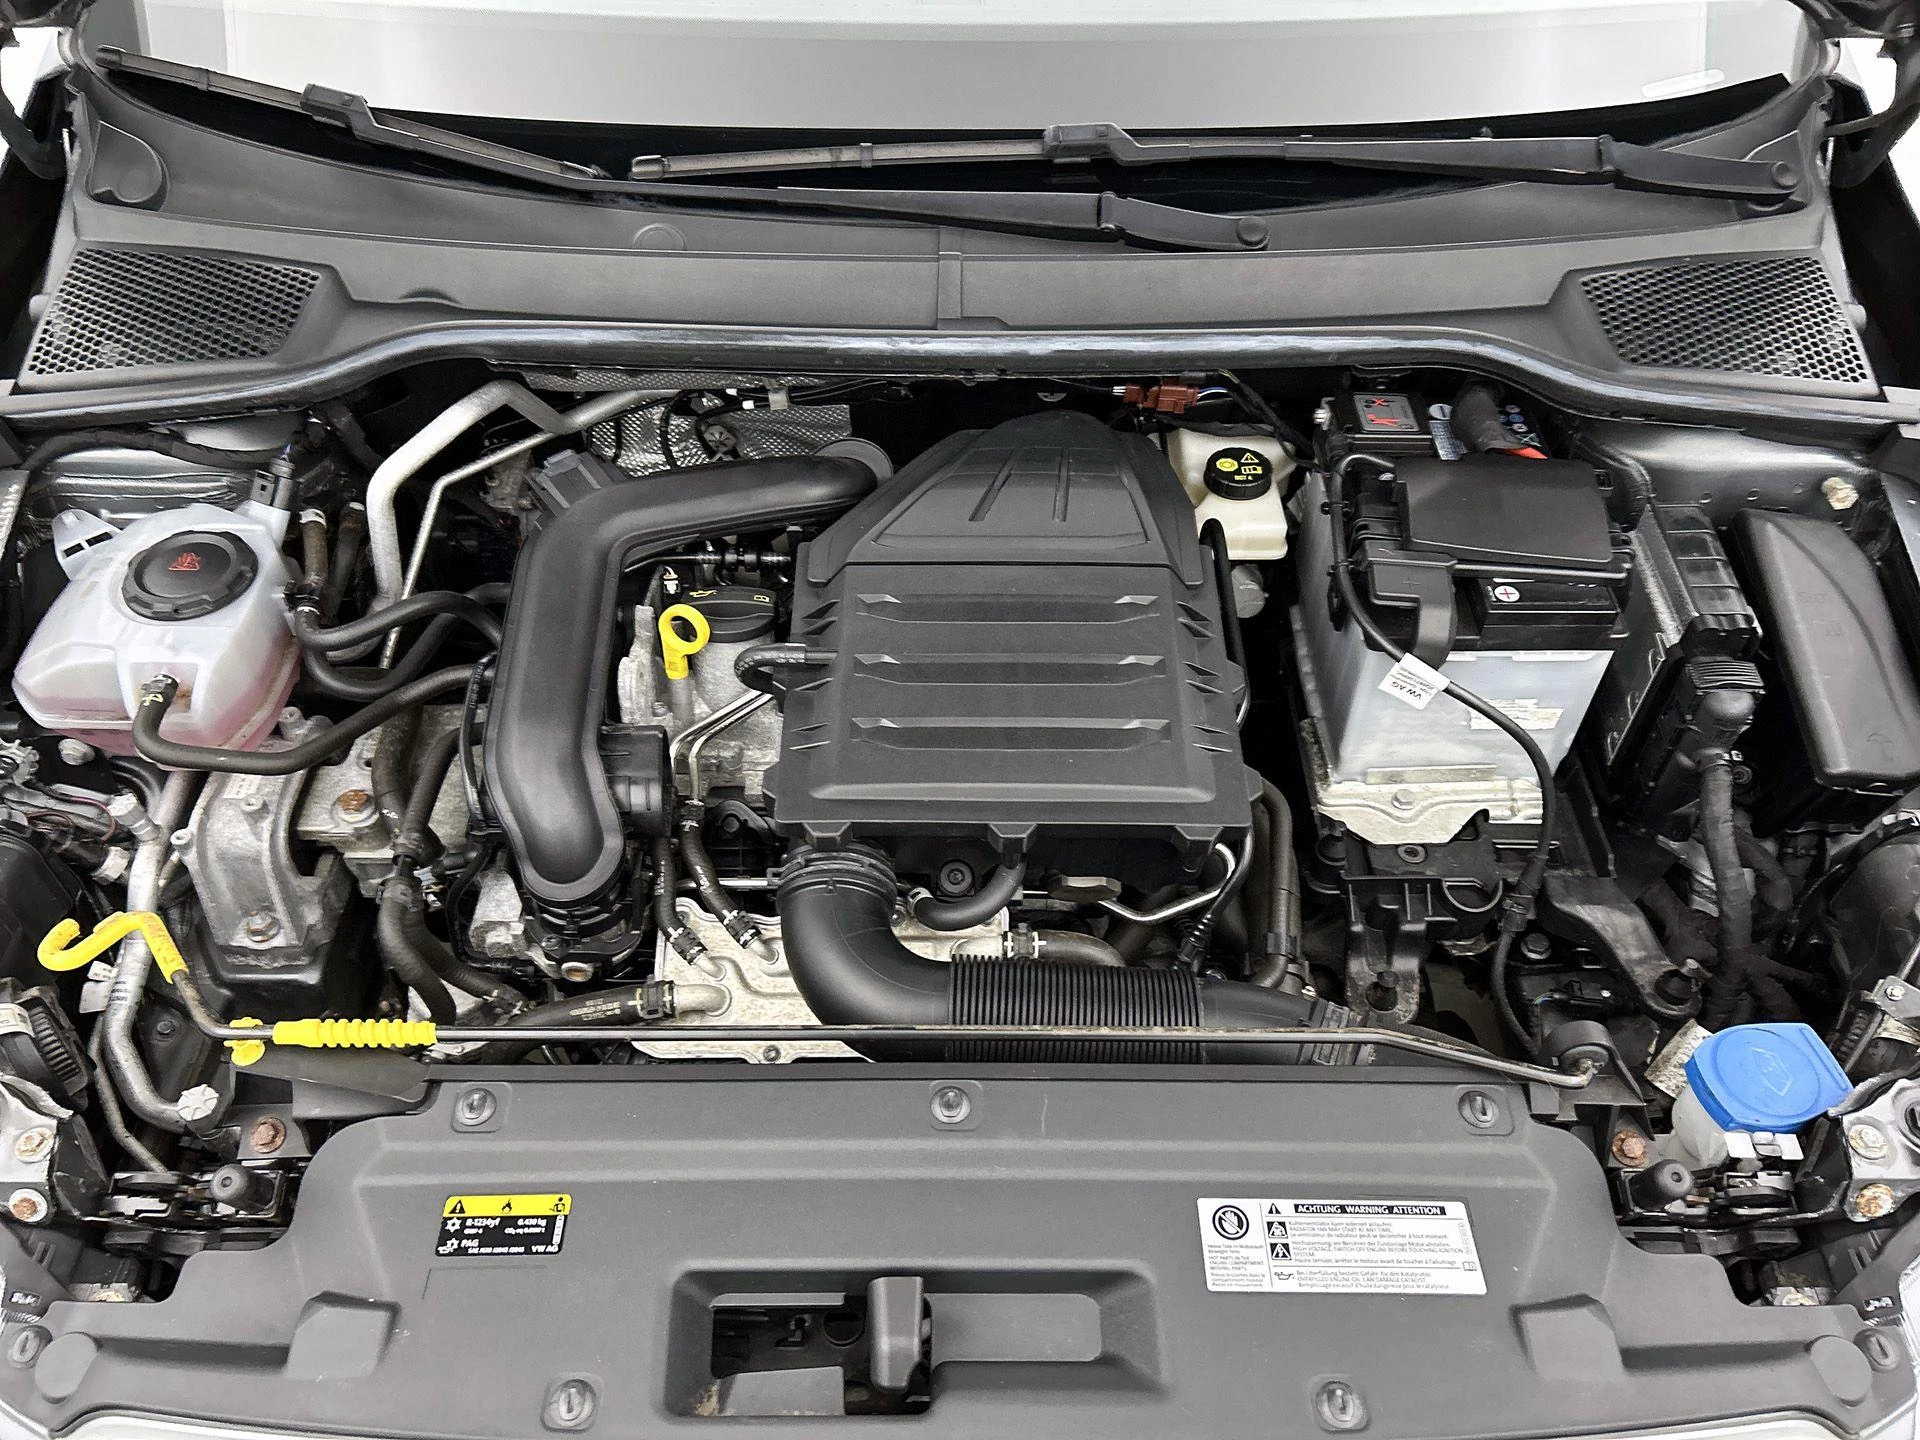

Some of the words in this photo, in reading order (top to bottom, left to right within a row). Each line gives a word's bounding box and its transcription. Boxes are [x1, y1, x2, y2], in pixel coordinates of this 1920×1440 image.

[1392, 681, 1406, 691] AG
[1406, 689, 1421, 700] VW
[1297, 1205, 1341, 1213] ACHTUNG
[1345, 1206, 1389, 1214] WARNING
[1393, 1206, 1441, 1215] ATTENTION
[465, 1217, 501, 1228] R-1234yf
[537, 1218, 547, 1227] kg
[460, 1239, 480, 1247] PAG
